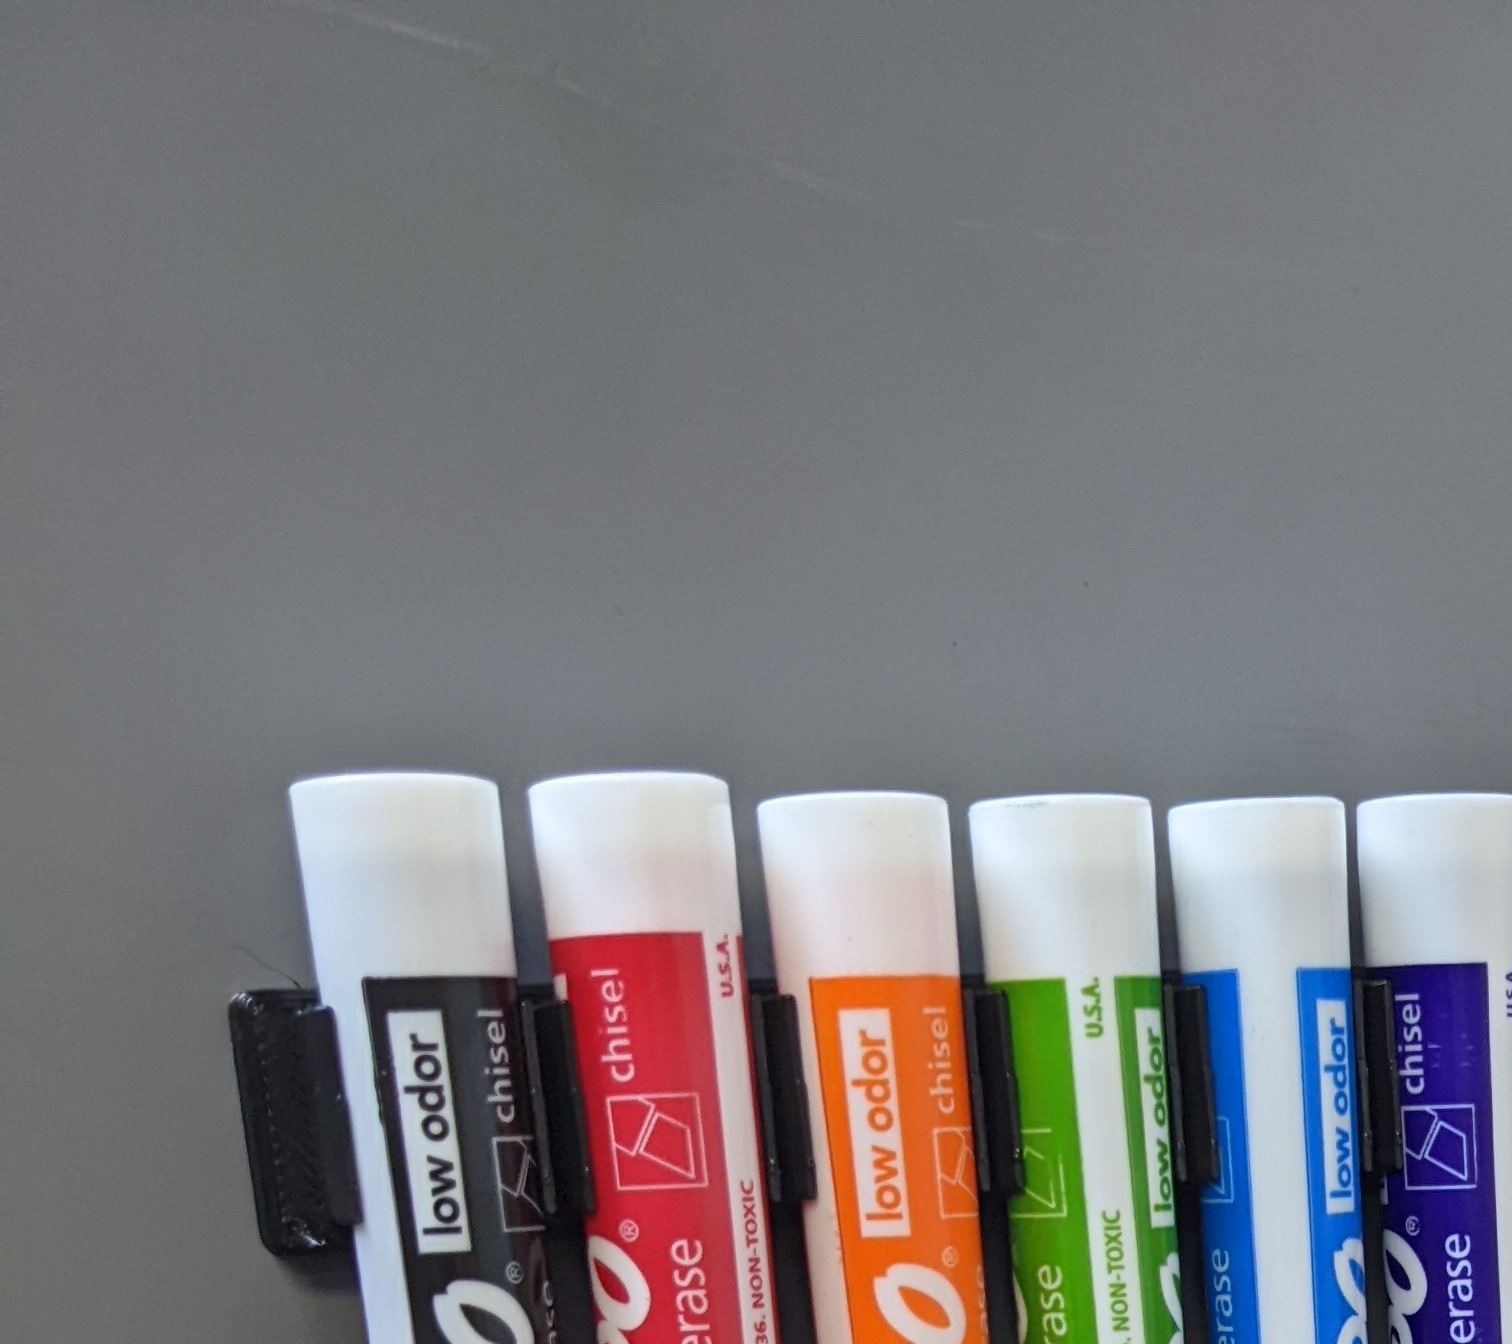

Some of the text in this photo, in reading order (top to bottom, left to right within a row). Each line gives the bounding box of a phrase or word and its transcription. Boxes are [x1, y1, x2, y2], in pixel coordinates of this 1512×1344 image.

[716, 934, 735, 998] U.S.A.
[1080, 976, 1101, 1039] U.S.A.
[477, 1009, 516, 1123] chisel
[591, 968, 635, 1083] chisel
[923, 1006, 955, 1114] chisel
[1395, 993, 1426, 1095] chisel
[404, 1032, 463, 1235] low odor
[851, 1028, 903, 1221] low odor
[1143, 1027, 1174, 1213] low odor
[1324, 1017, 1351, 1199] low odor
[739, 1179, 767, 1309] NON-TOXIC
[1101, 1210, 1131, 1332] NON-TOXIC
[1445, 1233, 1473, 1344] erase
